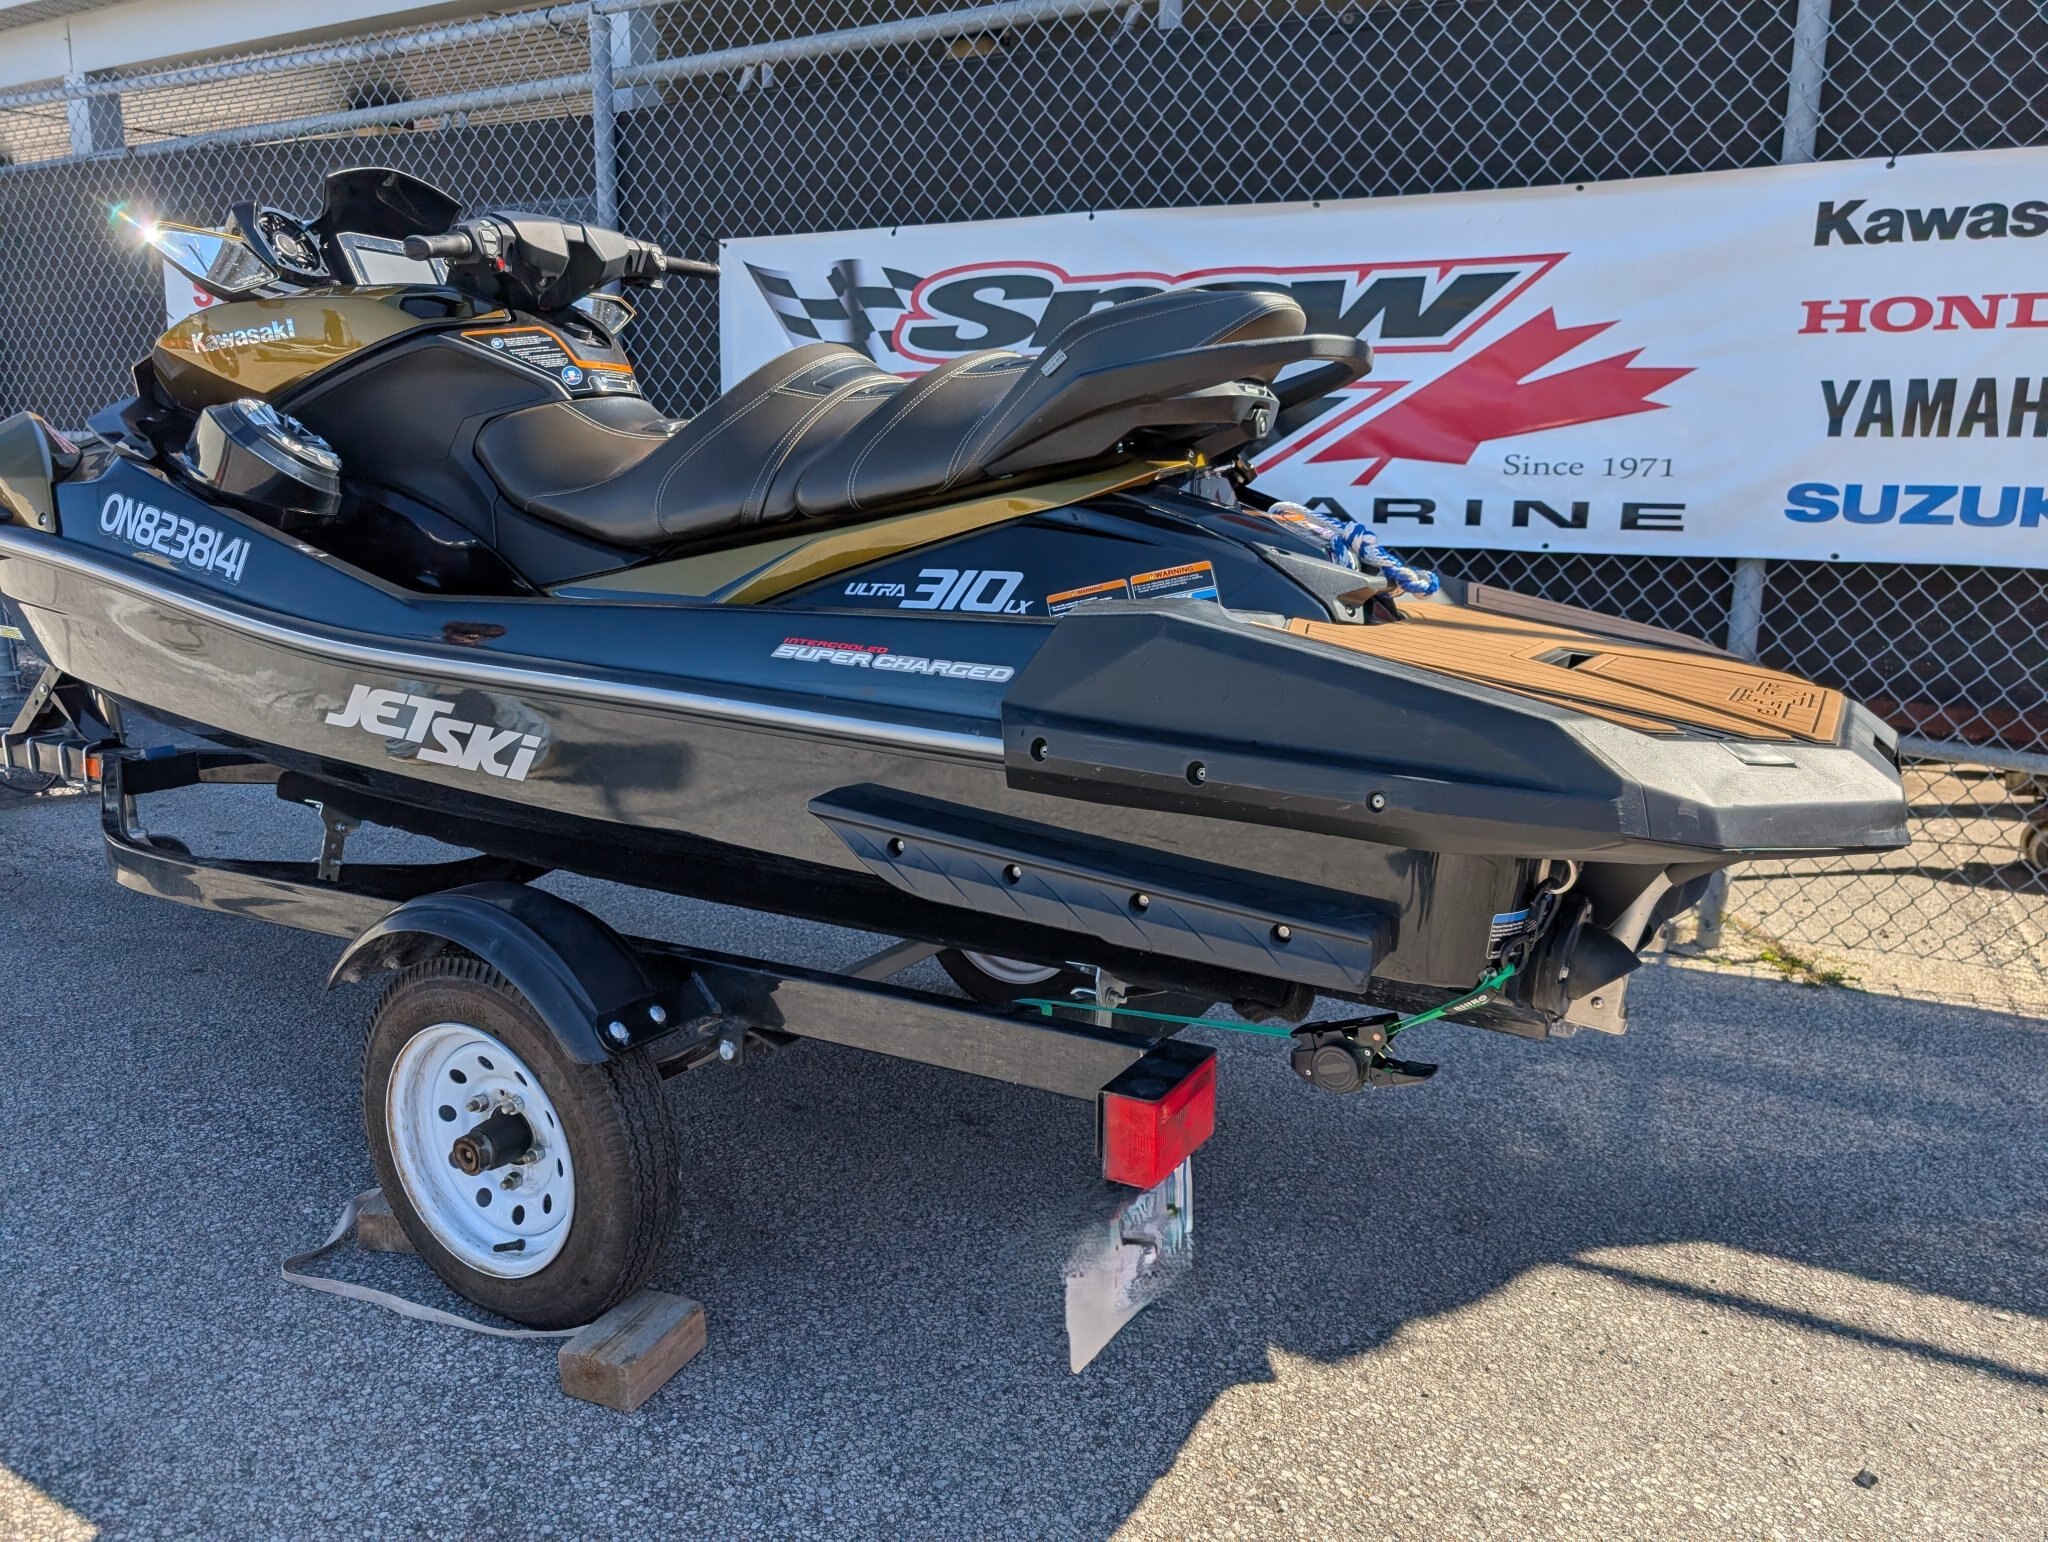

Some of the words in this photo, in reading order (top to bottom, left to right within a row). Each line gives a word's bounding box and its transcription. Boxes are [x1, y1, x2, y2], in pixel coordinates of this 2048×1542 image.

[1814, 199, 2048, 246] Kawas
[909, 271, 1521, 351] Snw
[191, 317, 296, 354] Kawasaki
[1820, 377, 2048, 438] YAMAH
[1503, 454, 1584, 476] Since
[1602, 457, 1675, 479] 1971
[1304, 496, 1686, 531] ARINE
[100, 492, 251, 584] ON8238141
[1154, 565, 1194, 578] WARNING
[844, 582, 905, 597] ULTRA
[1077, 585, 1103, 595] WARNING
[783, 637, 889, 654] INTERCOOLED
